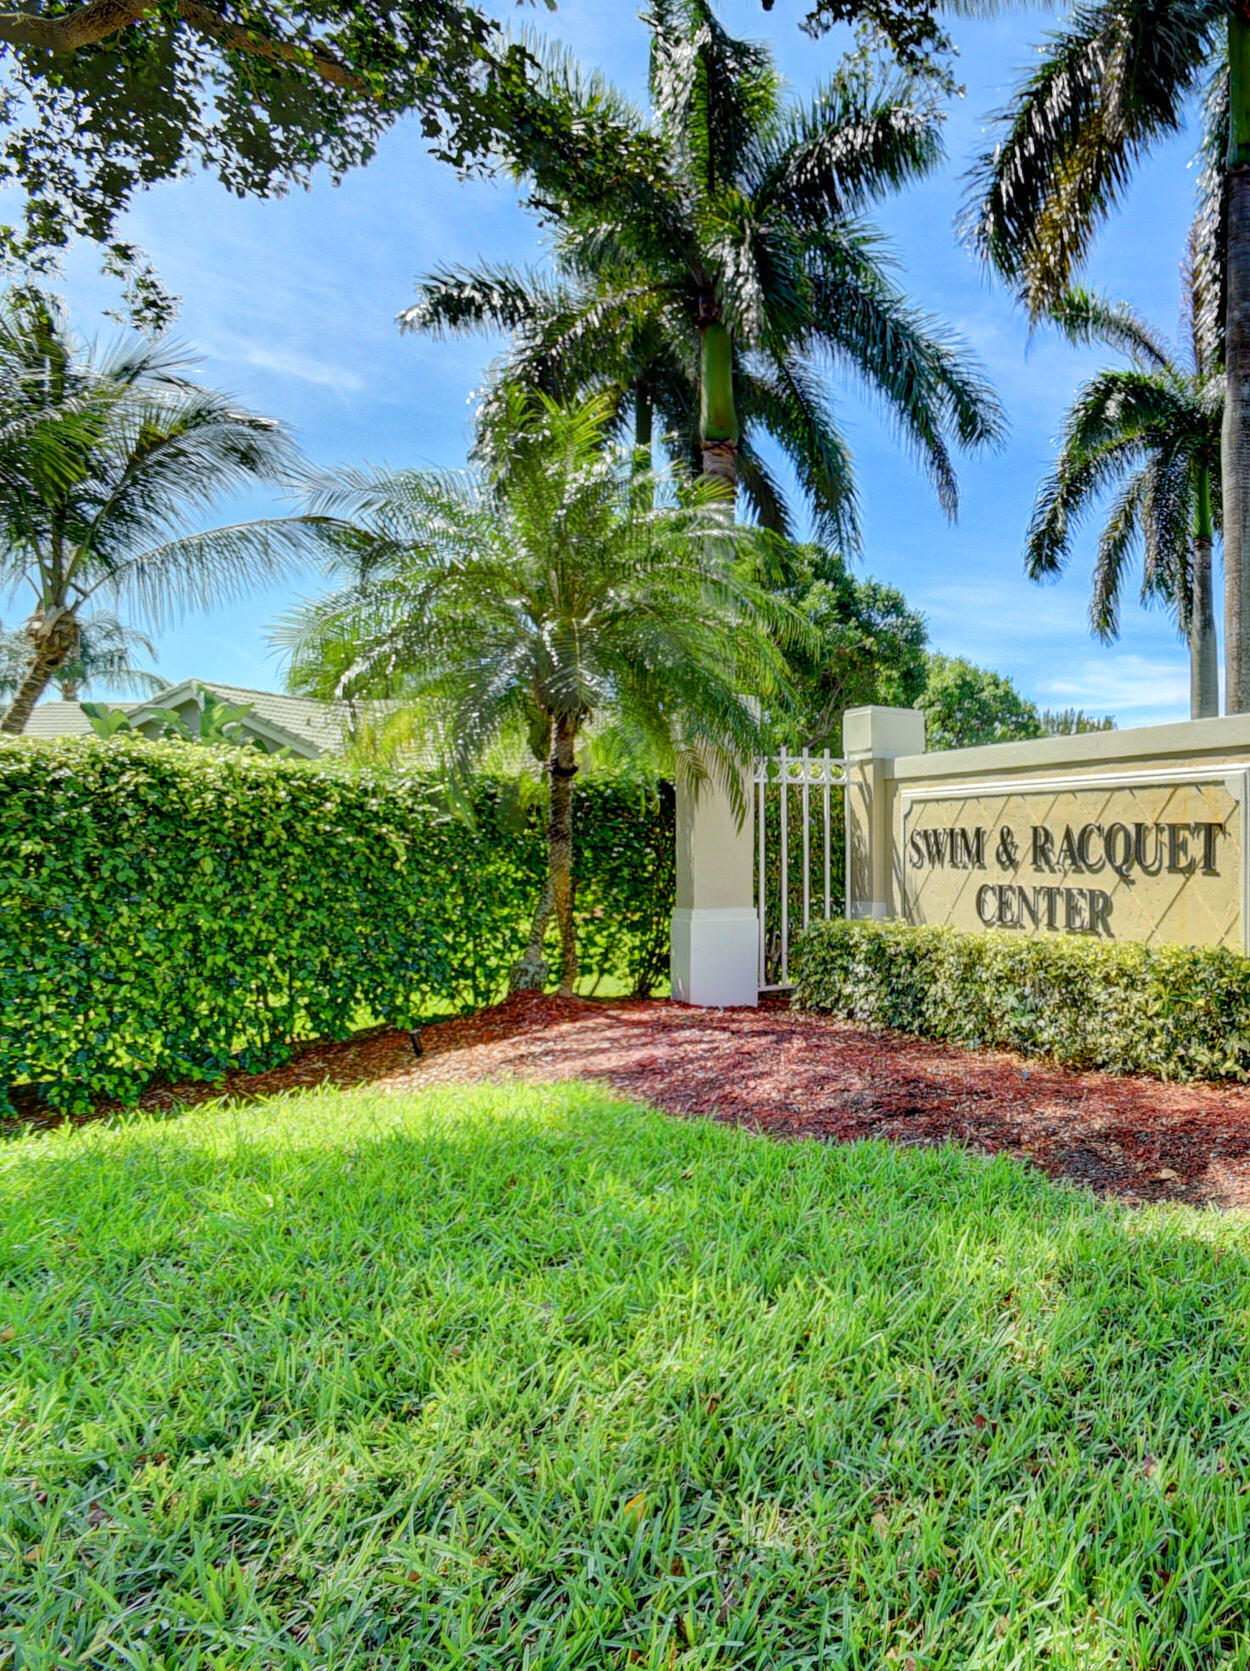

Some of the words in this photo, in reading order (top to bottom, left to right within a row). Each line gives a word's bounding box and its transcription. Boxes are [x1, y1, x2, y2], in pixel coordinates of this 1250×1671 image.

[910, 827, 987, 869] SWIM
[996, 825, 1019, 871] &
[1030, 822, 1227, 884] RACQUET
[976, 884, 1115, 938] CENTER
